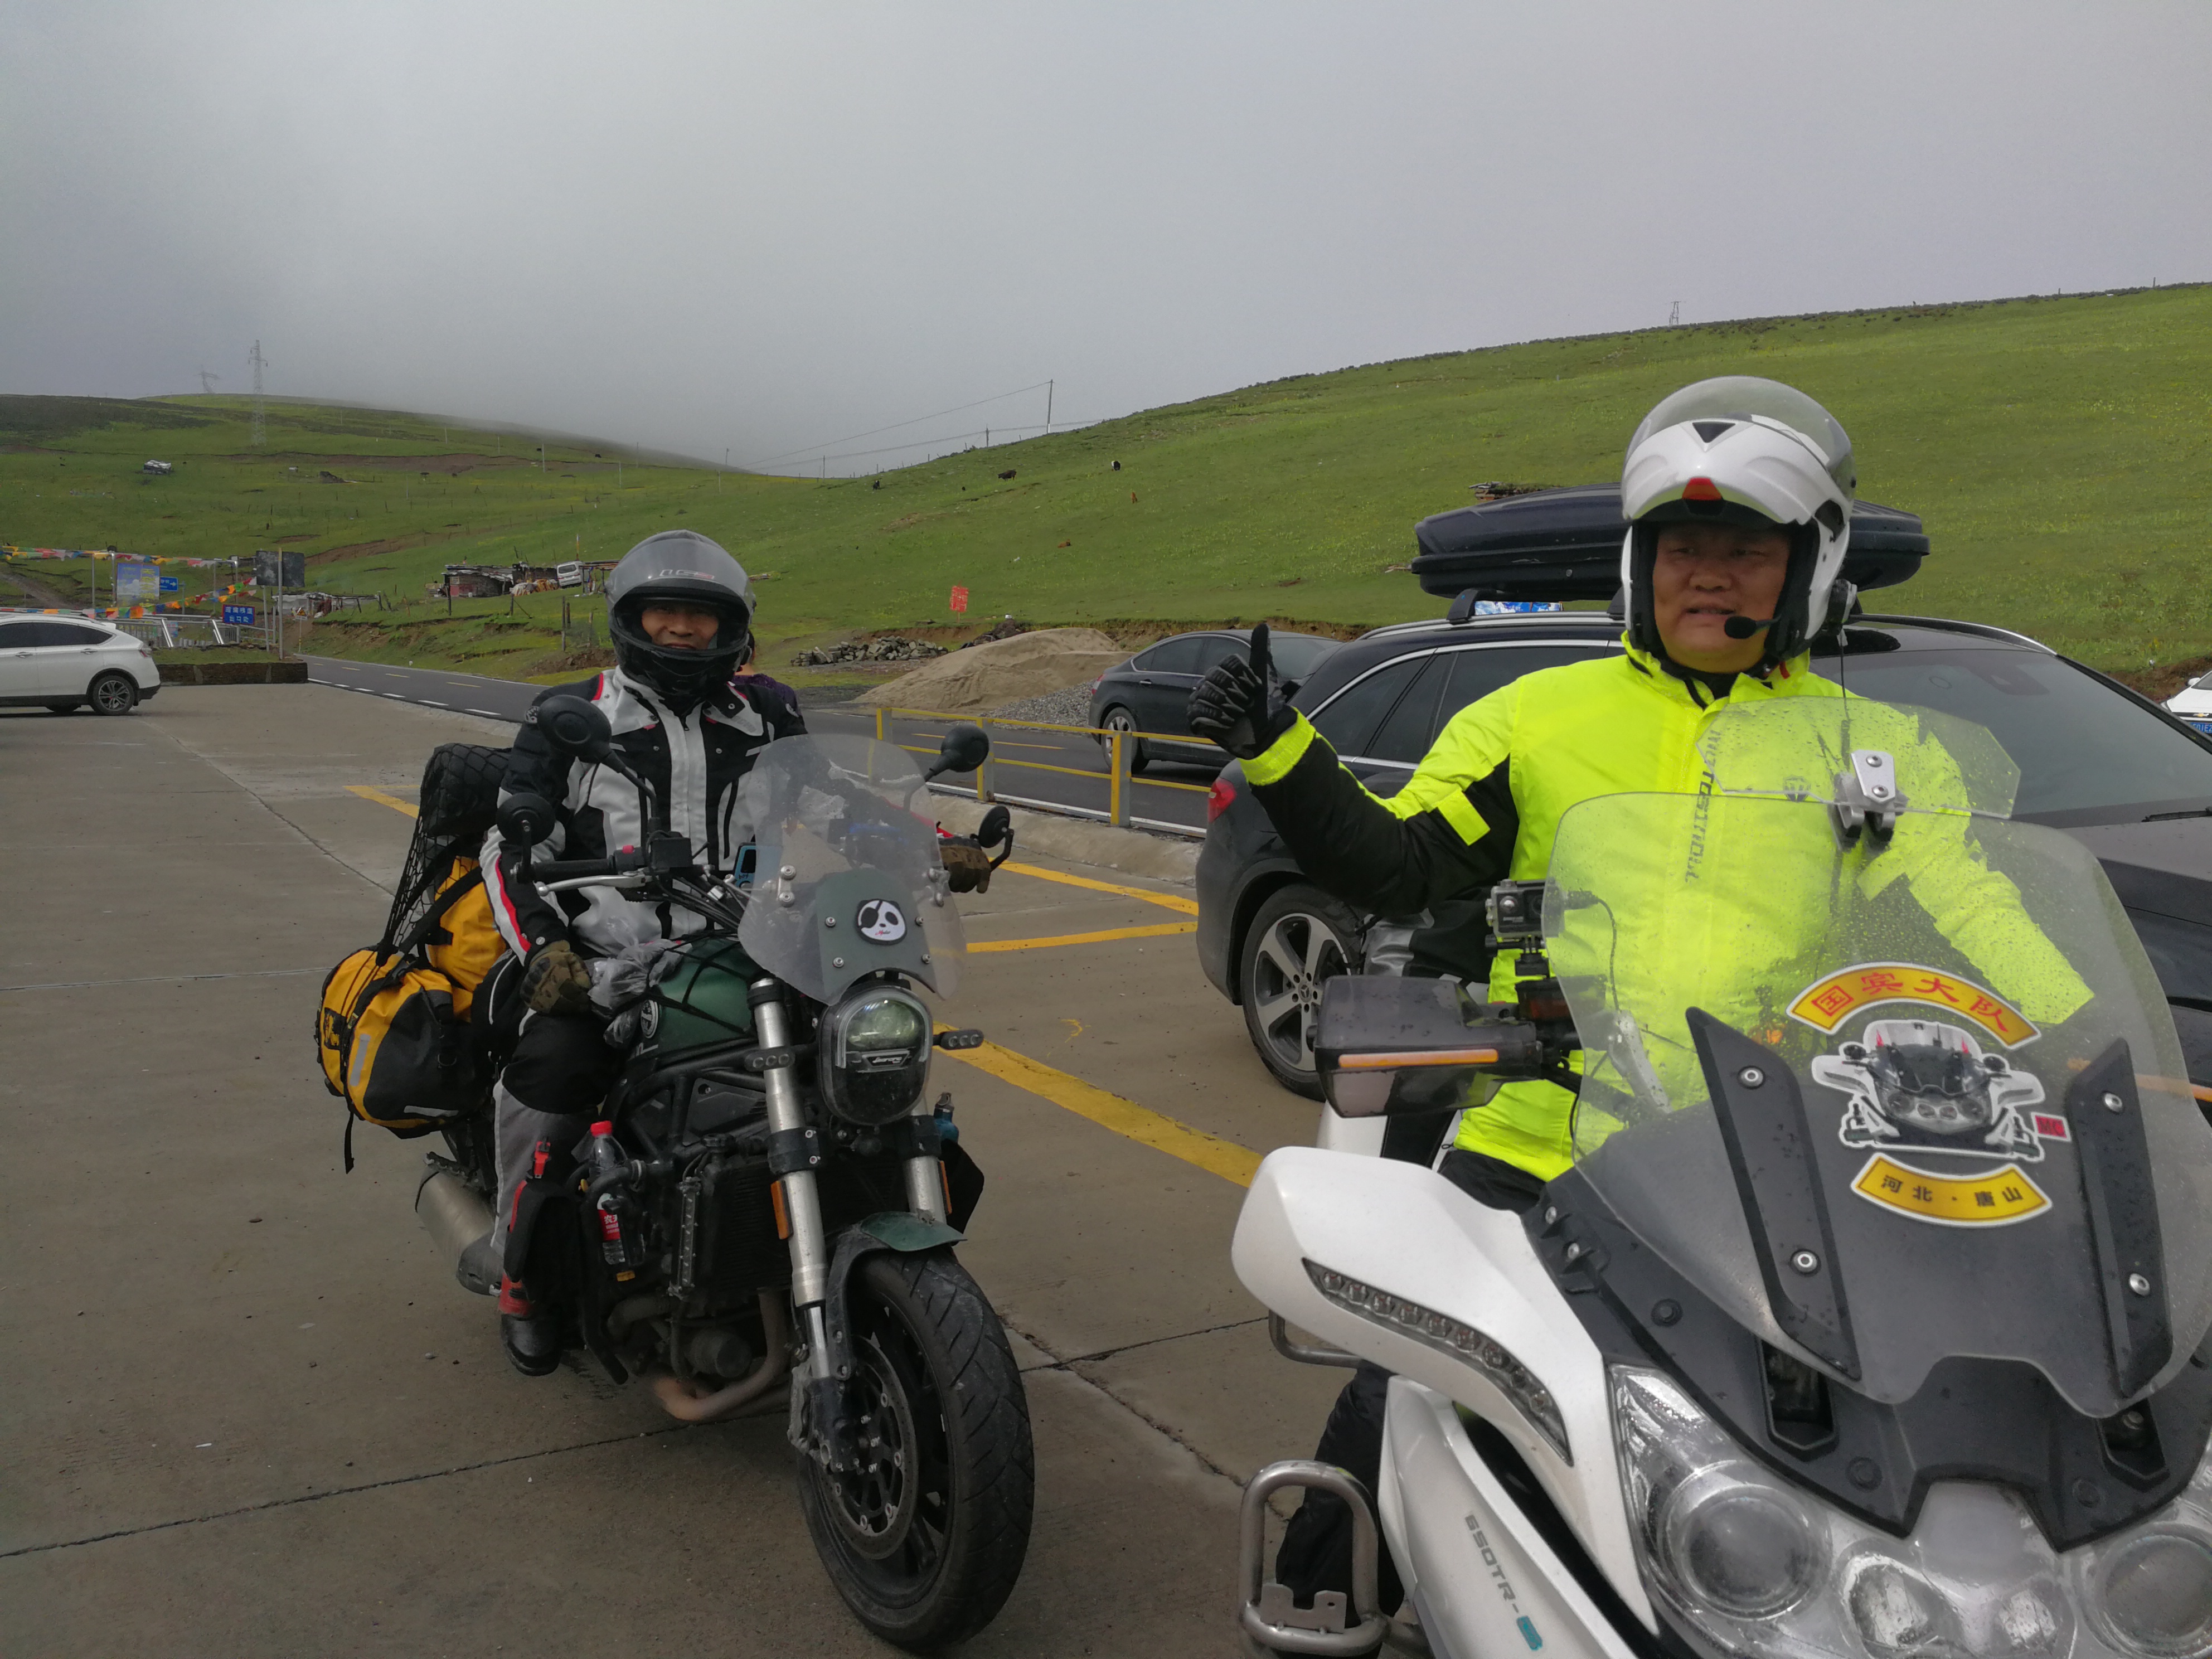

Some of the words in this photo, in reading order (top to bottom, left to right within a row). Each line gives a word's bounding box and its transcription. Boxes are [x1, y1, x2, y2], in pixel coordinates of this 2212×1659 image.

[1811, 971, 2009, 1034] 国宾大队
[2039, 1117, 2064, 1138] MC
[1881, 1174, 2024, 1208] 河北·唐山
